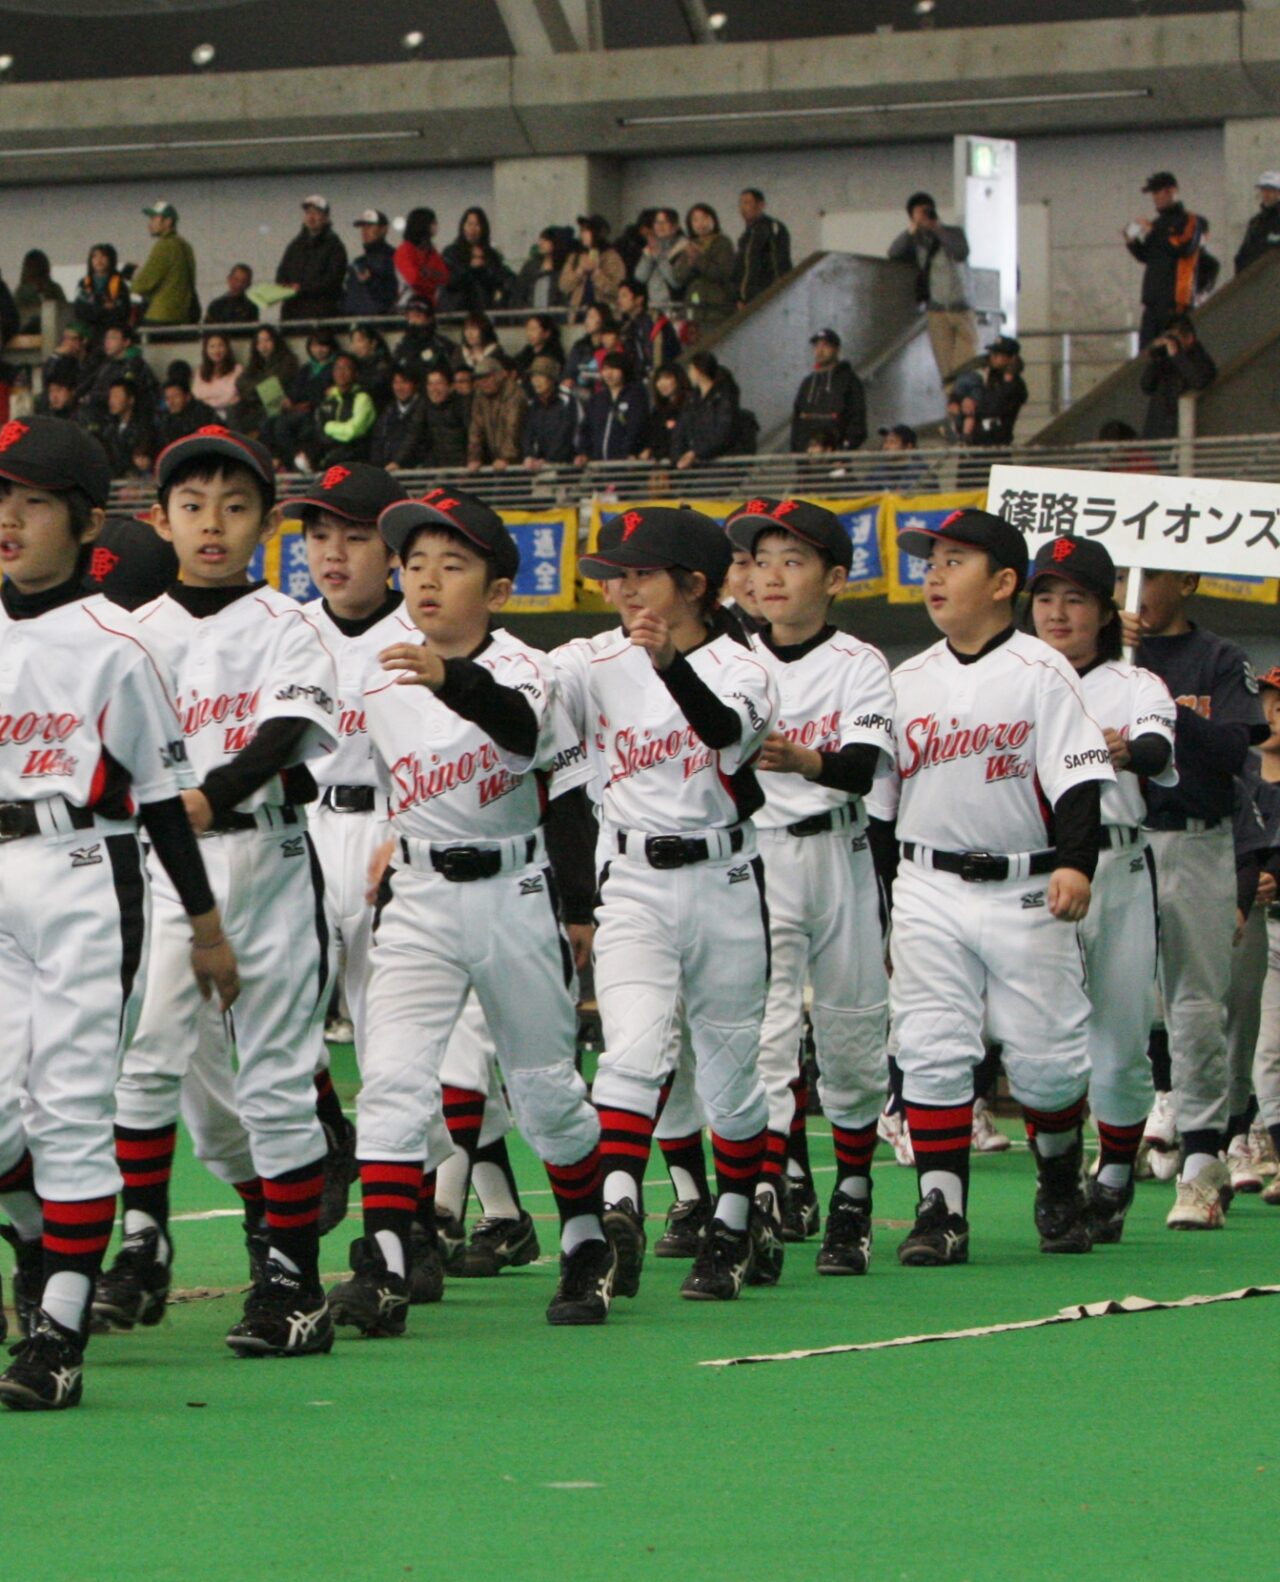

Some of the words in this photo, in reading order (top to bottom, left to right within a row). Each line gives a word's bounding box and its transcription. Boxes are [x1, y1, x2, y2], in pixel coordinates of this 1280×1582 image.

[998, 488, 1280, 550] 篠路ライオンズ
[898, 711, 1036, 779] Shinoro
